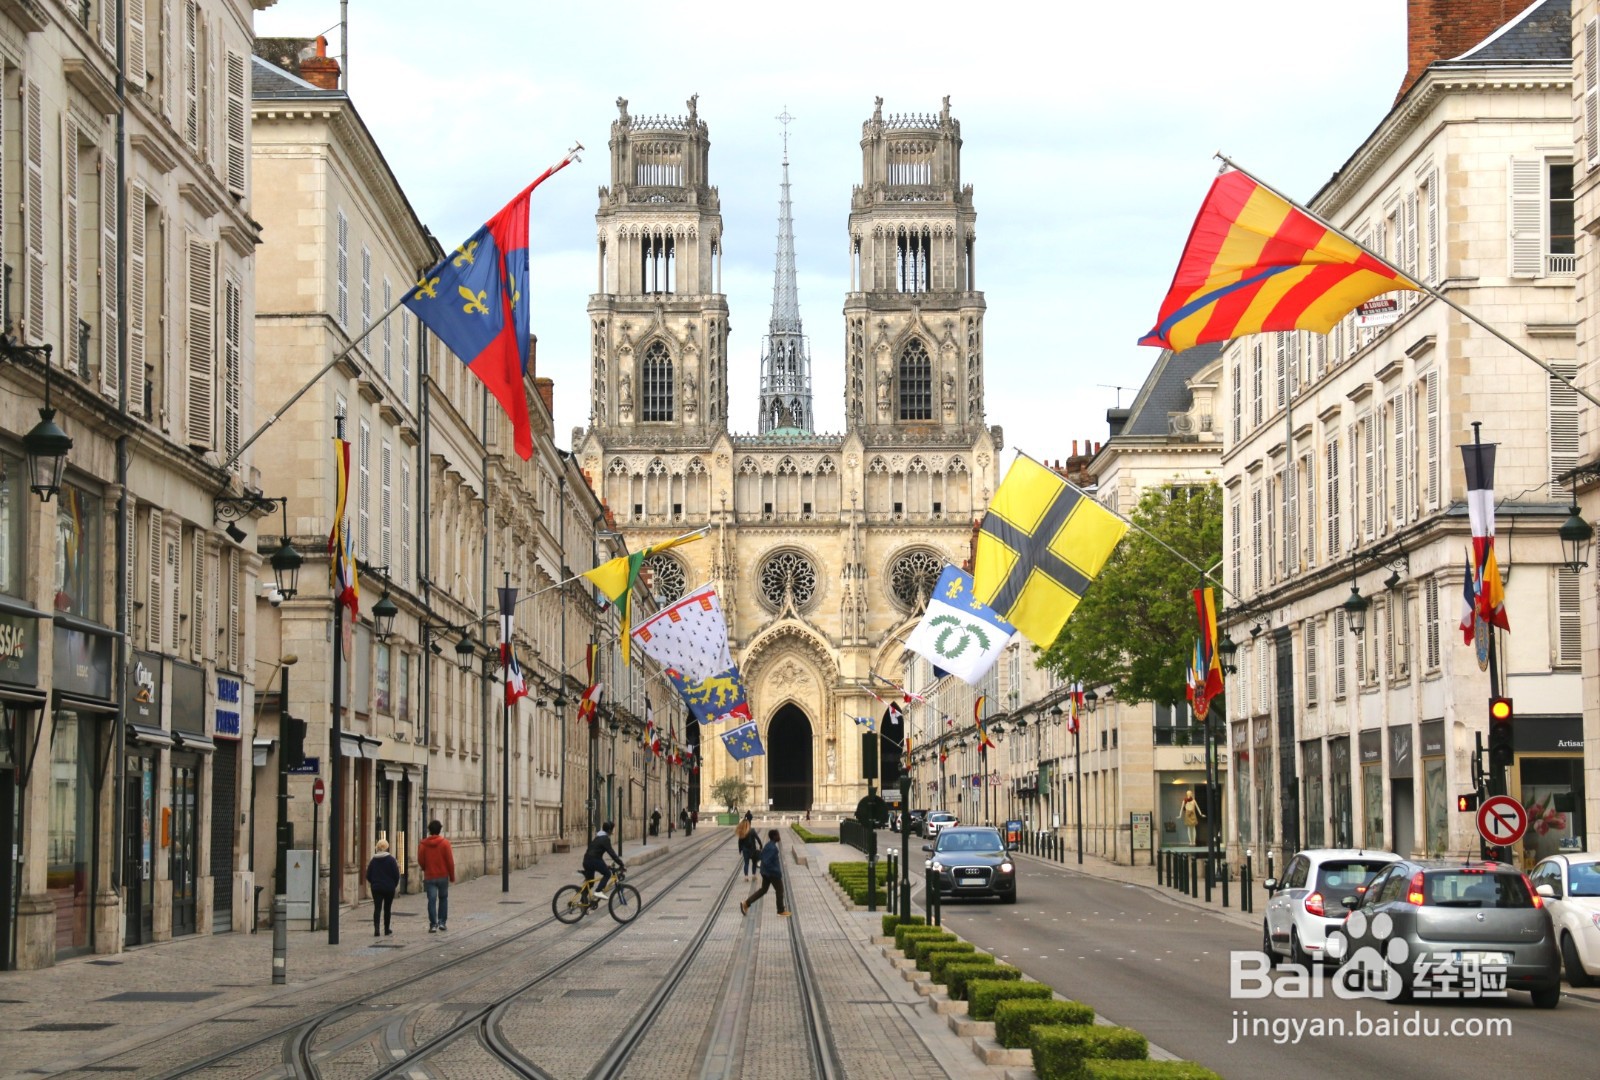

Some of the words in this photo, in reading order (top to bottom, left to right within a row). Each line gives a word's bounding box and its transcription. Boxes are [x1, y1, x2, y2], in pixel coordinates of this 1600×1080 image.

[217, 677, 239, 704] TABAC
[215, 709, 240, 735] PRESSE
[1183, 753, 1228, 764] UNID
